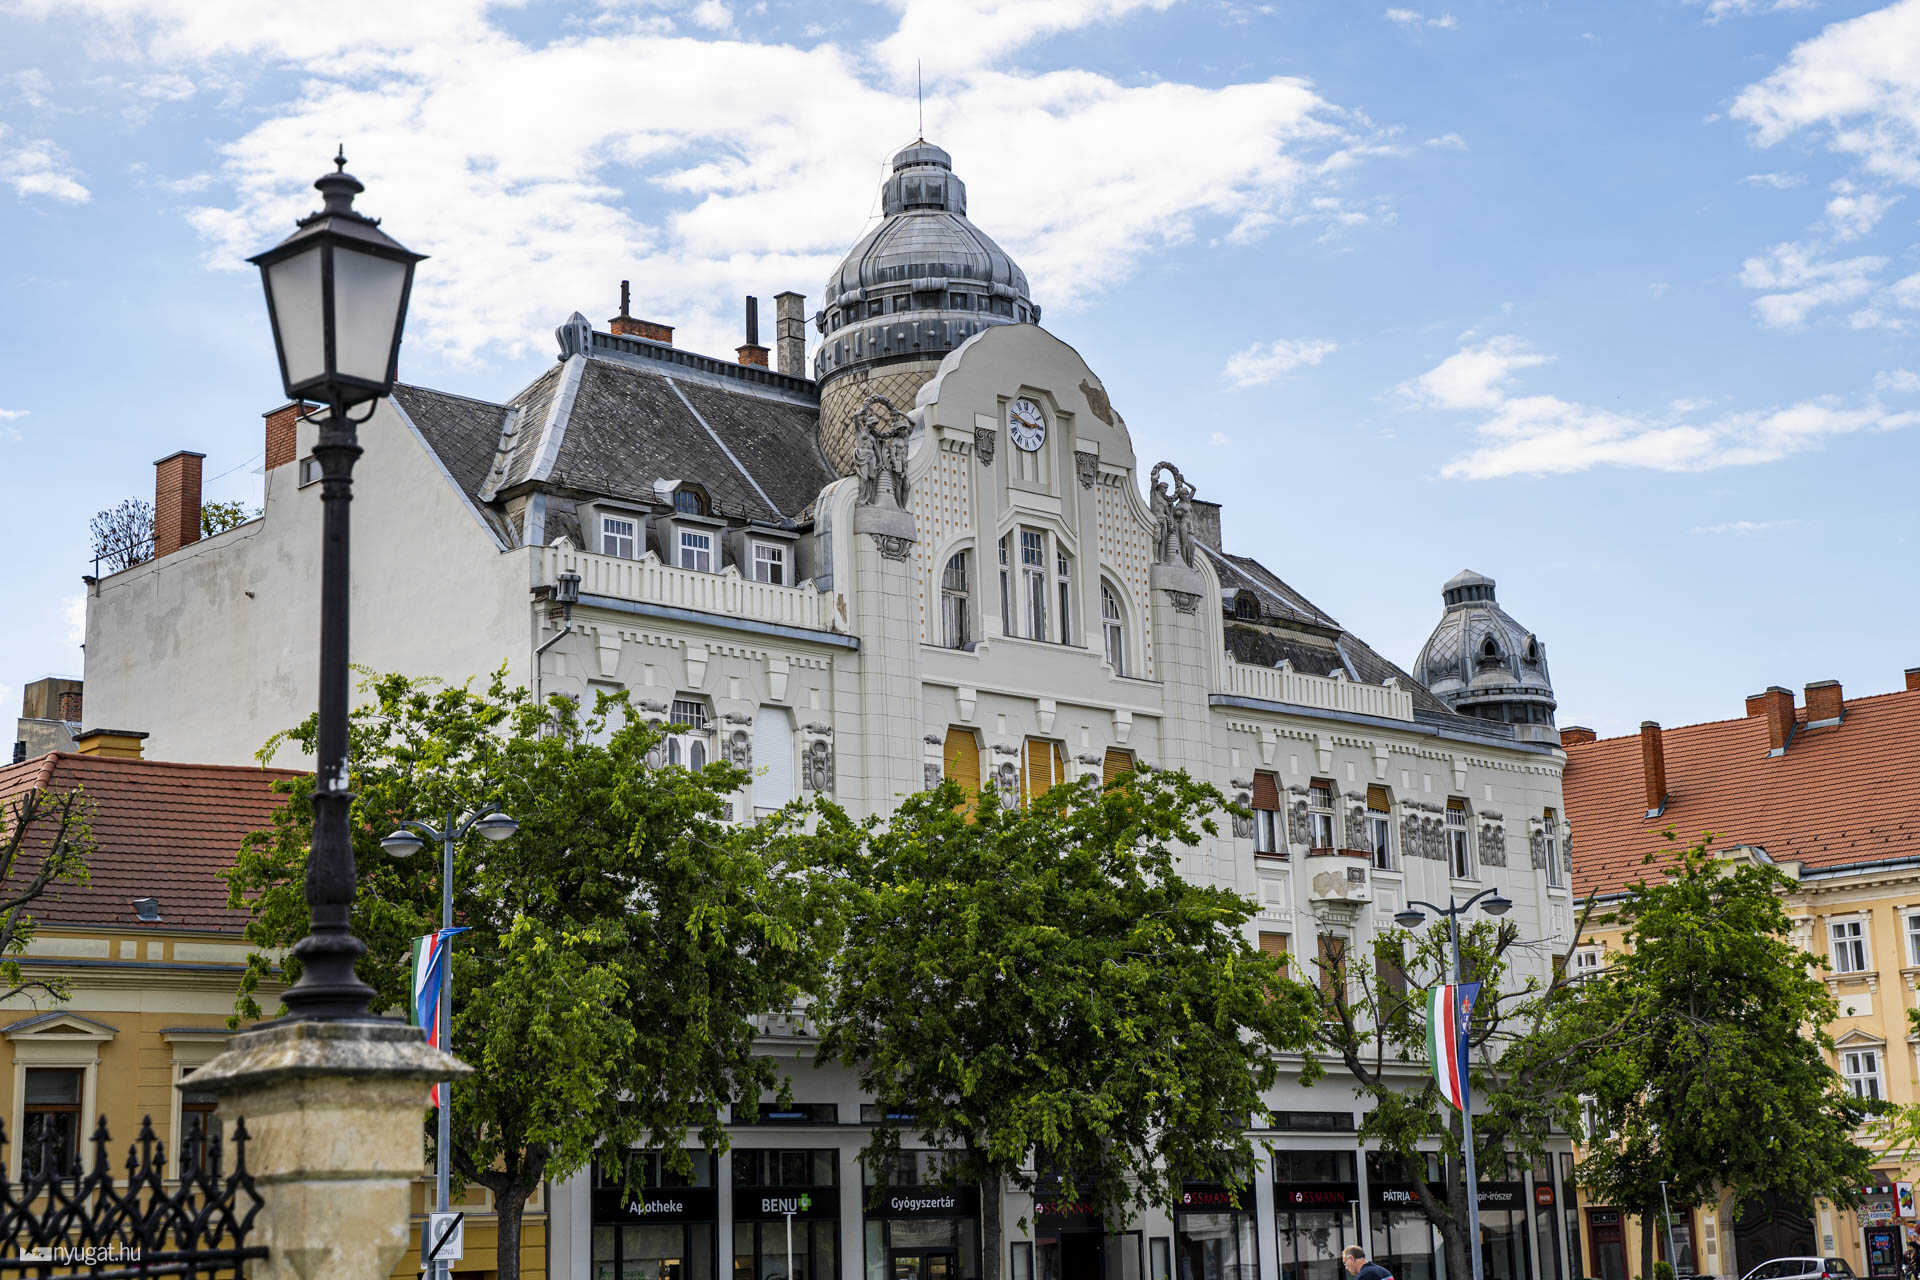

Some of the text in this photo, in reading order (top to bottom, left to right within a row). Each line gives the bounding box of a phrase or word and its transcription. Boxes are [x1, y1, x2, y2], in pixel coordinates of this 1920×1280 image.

[629, 1199, 684, 1216] Apotheke
[761, 1198, 798, 1212] BENU
[891, 1195, 955, 1211] Gyógyszertár
